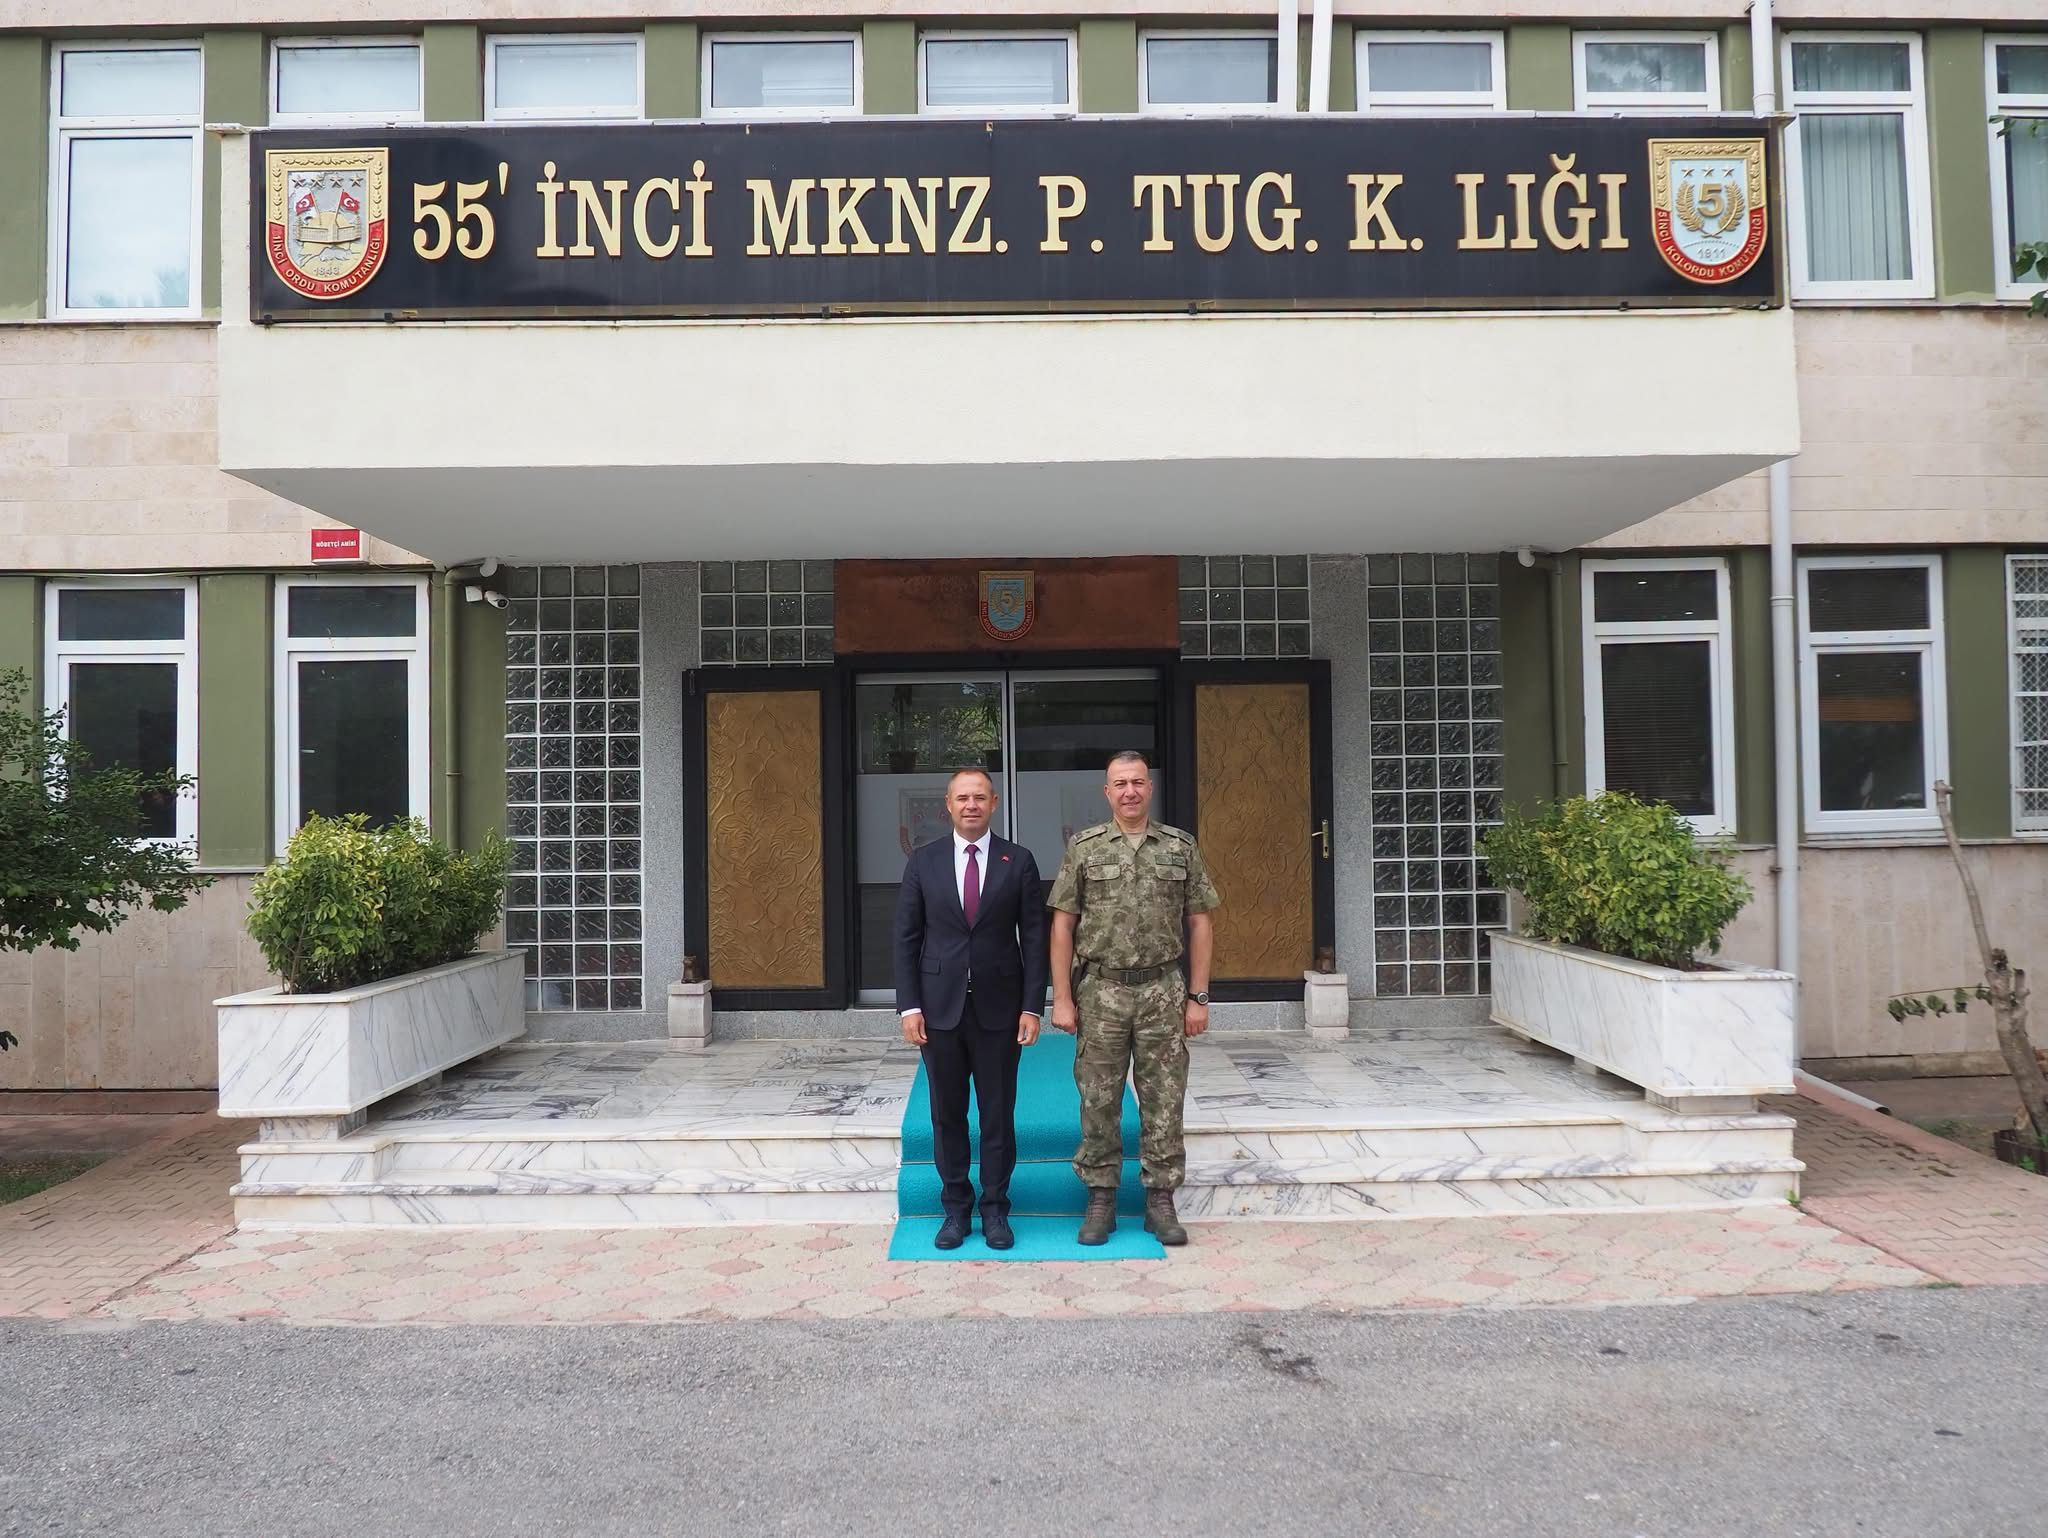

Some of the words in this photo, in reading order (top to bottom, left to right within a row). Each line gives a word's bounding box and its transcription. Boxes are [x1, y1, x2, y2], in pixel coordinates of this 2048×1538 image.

[412, 160, 508, 259] 55'
[536, 159, 712, 257] İNCİ
[746, 176, 1008, 255] MKNZ.
[1037, 174, 1103, 253] P.
[1132, 170, 1318, 252] TUG.
[1346, 173, 1423, 250] K.
[1455, 151, 1629, 250] LIĞI
[1697, 183, 1724, 217] 5
[285, 269, 315, 291] ORDU
[323, 237, 381, 293] KOMUTANLIĞI
[1665, 245, 1715, 277] KOLORDU
[1000, 590, 1016, 609] 5
